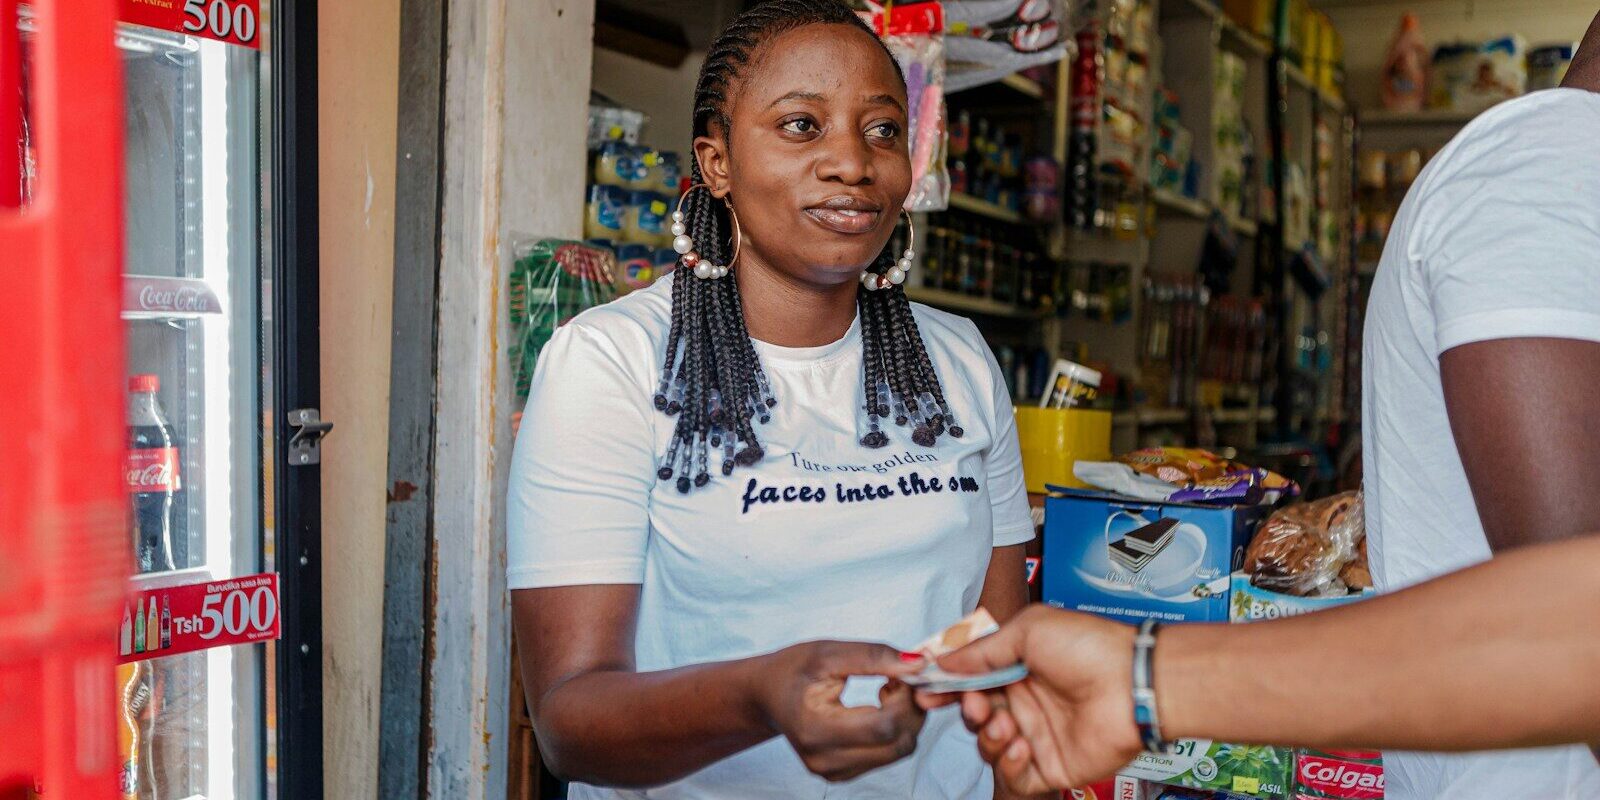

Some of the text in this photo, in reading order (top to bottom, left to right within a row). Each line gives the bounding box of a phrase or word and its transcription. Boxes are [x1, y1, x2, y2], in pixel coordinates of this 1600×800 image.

[183, 0, 255, 42] 500
[140, 285, 208, 311] Coca-Cola
[872, 451, 938, 474] golden
[742, 478, 826, 514] faces
[836, 482, 894, 503] into
[897, 472, 943, 496] the
[173, 586, 276, 640] Tsh 500
[130, 682, 149, 715] TONEY
[1258, 783, 1283, 795] ASIL
[1302, 761, 1385, 789] Colgat
